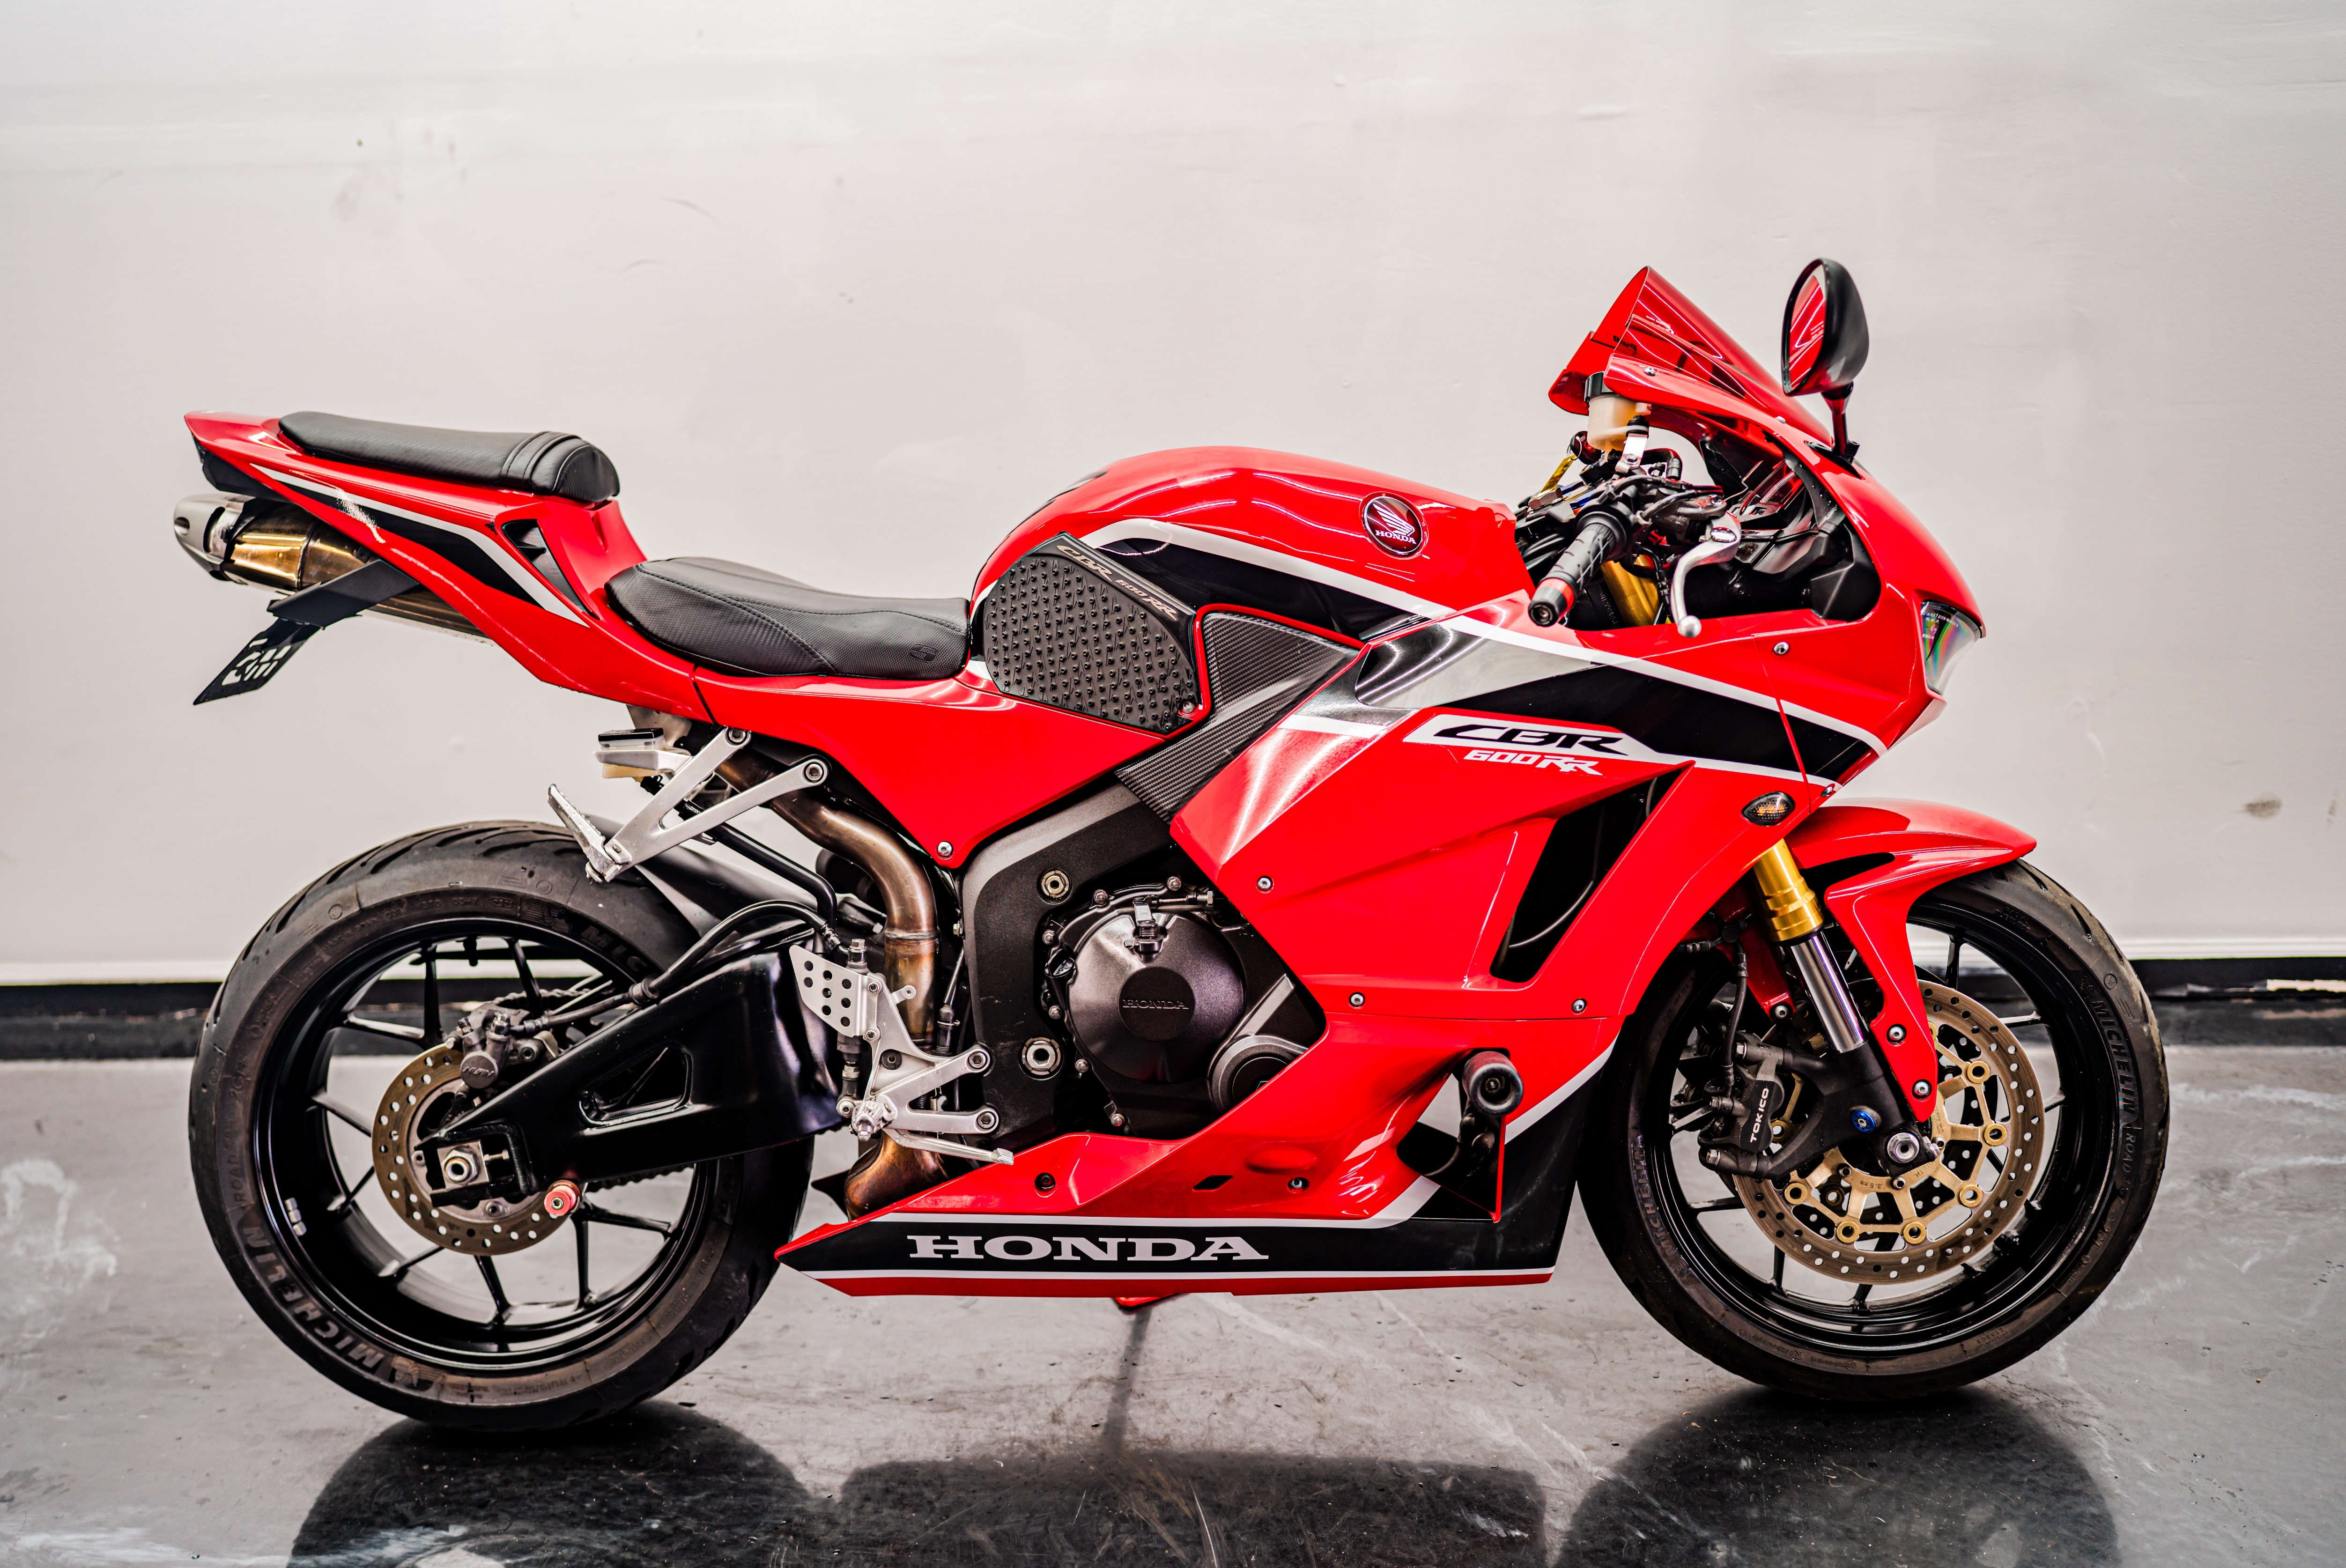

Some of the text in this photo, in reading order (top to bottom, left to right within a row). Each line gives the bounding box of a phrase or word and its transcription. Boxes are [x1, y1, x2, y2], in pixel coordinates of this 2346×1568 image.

[1376, 530, 1416, 544] HONDA
[1057, 545, 1177, 621] CBR 600 RR
[1434, 724, 1629, 756] CBR
[1463, 749, 1603, 776] 600RR
[1123, 999, 1189, 1009] HONDA
[2090, 996, 2136, 1114] MICHELIN
[1750, 1087, 1769, 1143] TOKICO
[2121, 1132, 2136, 1173] ROAD
[1633, 1146, 1676, 1257] MICHELIN
[907, 1235, 1269, 1261] HONDA
[243, 1227, 386, 1376] MICHELIN
